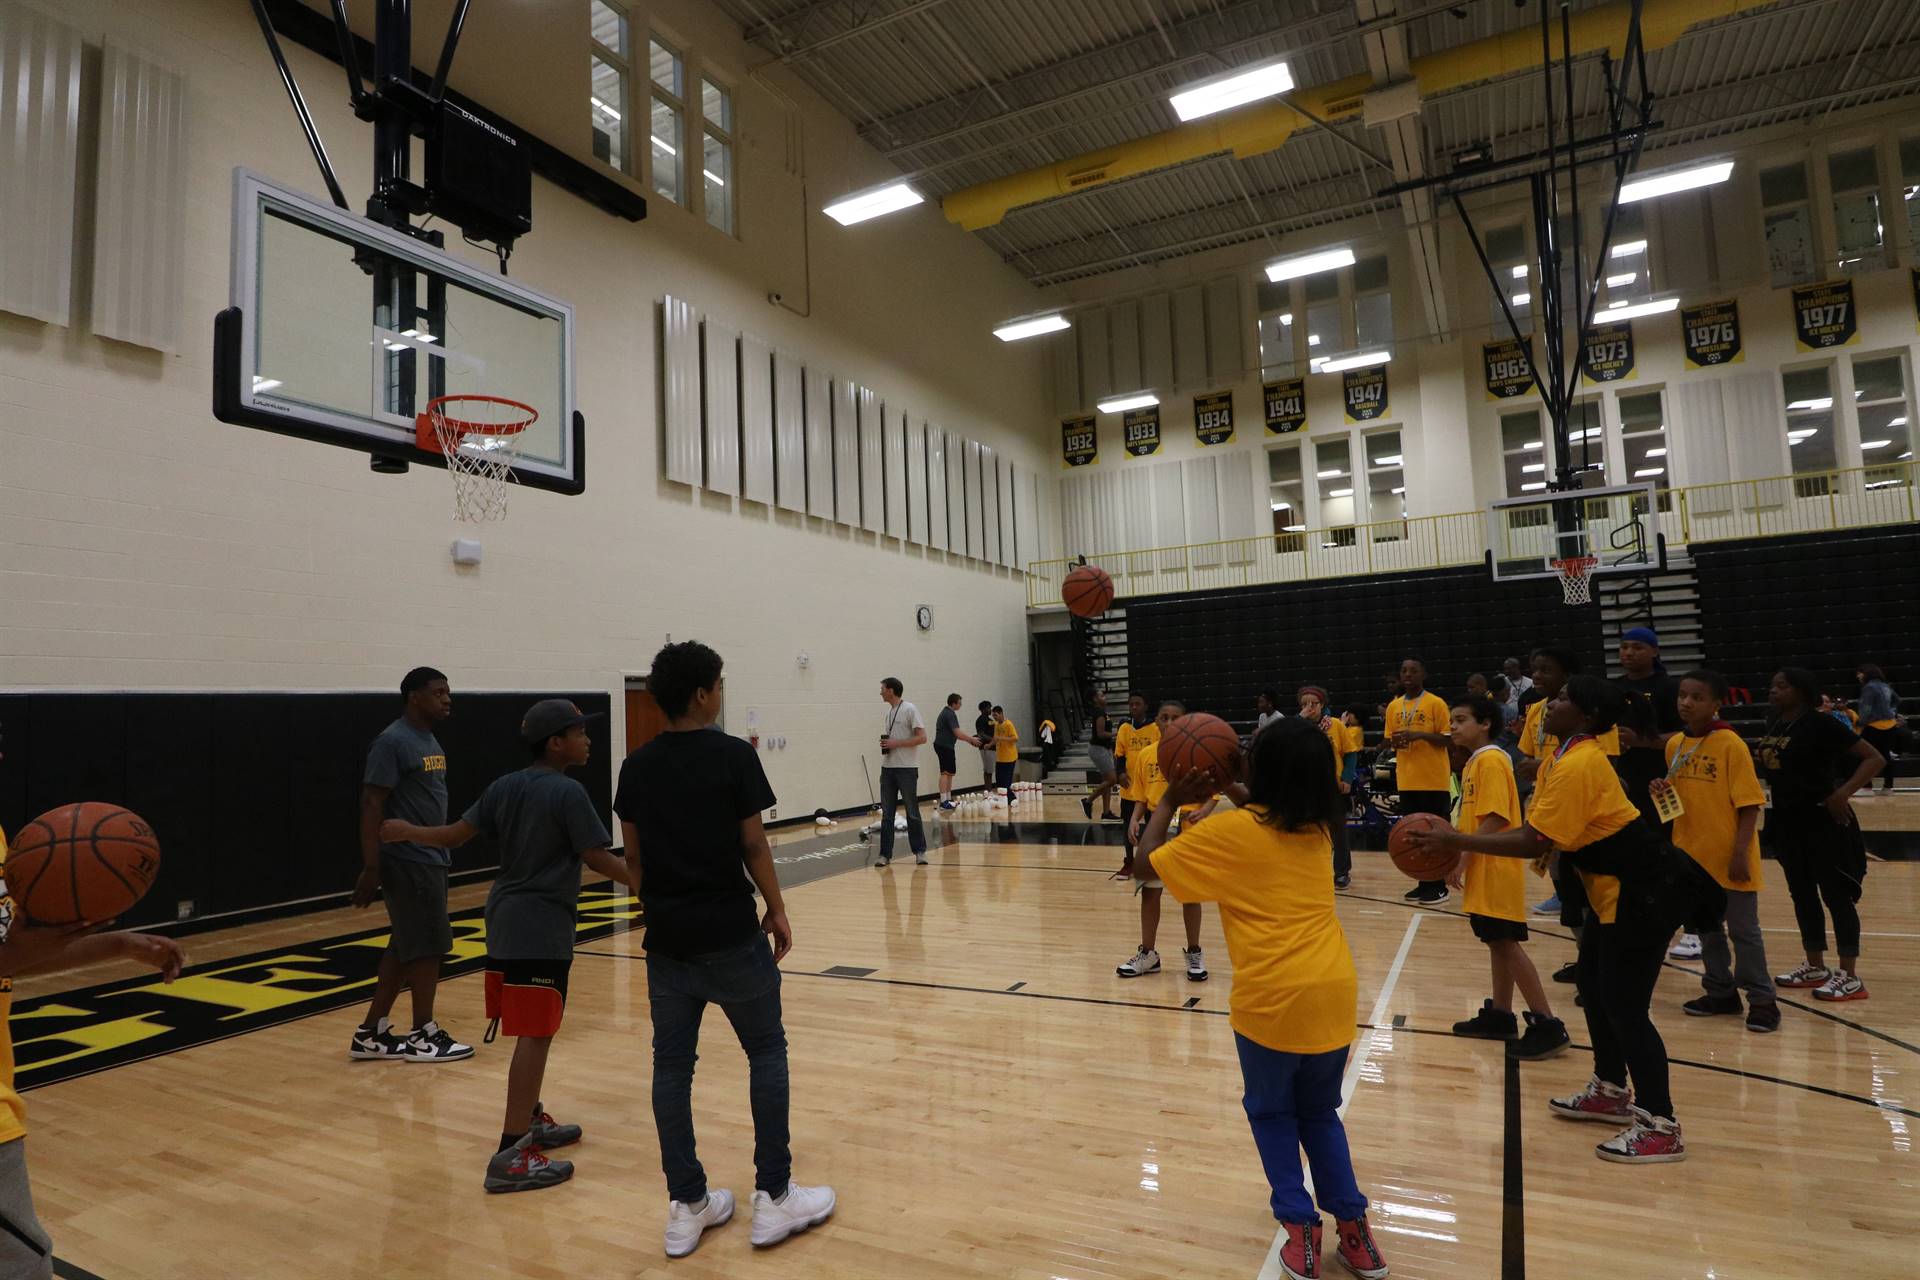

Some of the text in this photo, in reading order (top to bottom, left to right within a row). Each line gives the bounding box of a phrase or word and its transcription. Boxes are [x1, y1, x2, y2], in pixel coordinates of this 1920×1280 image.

[461, 110, 517, 146] DAKTRONICS
[1799, 292, 1849, 309] CHAMPIONS
[1686, 313, 1735, 328] CHAMPIONS
[1802, 303, 1848, 329] 1977
[1585, 331, 1629, 346] CHAMPIONS
[1690, 322, 1735, 348] 1976
[1587, 340, 1628, 365] 1973
[1490, 358, 1530, 381] 1965
[1348, 382, 1384, 405] 1947
[1269, 397, 1301, 418] 1941
[1199, 409, 1229, 430] 1934
[1066, 432, 1093, 451] 1932
[1128, 422, 1156, 441] 1933
